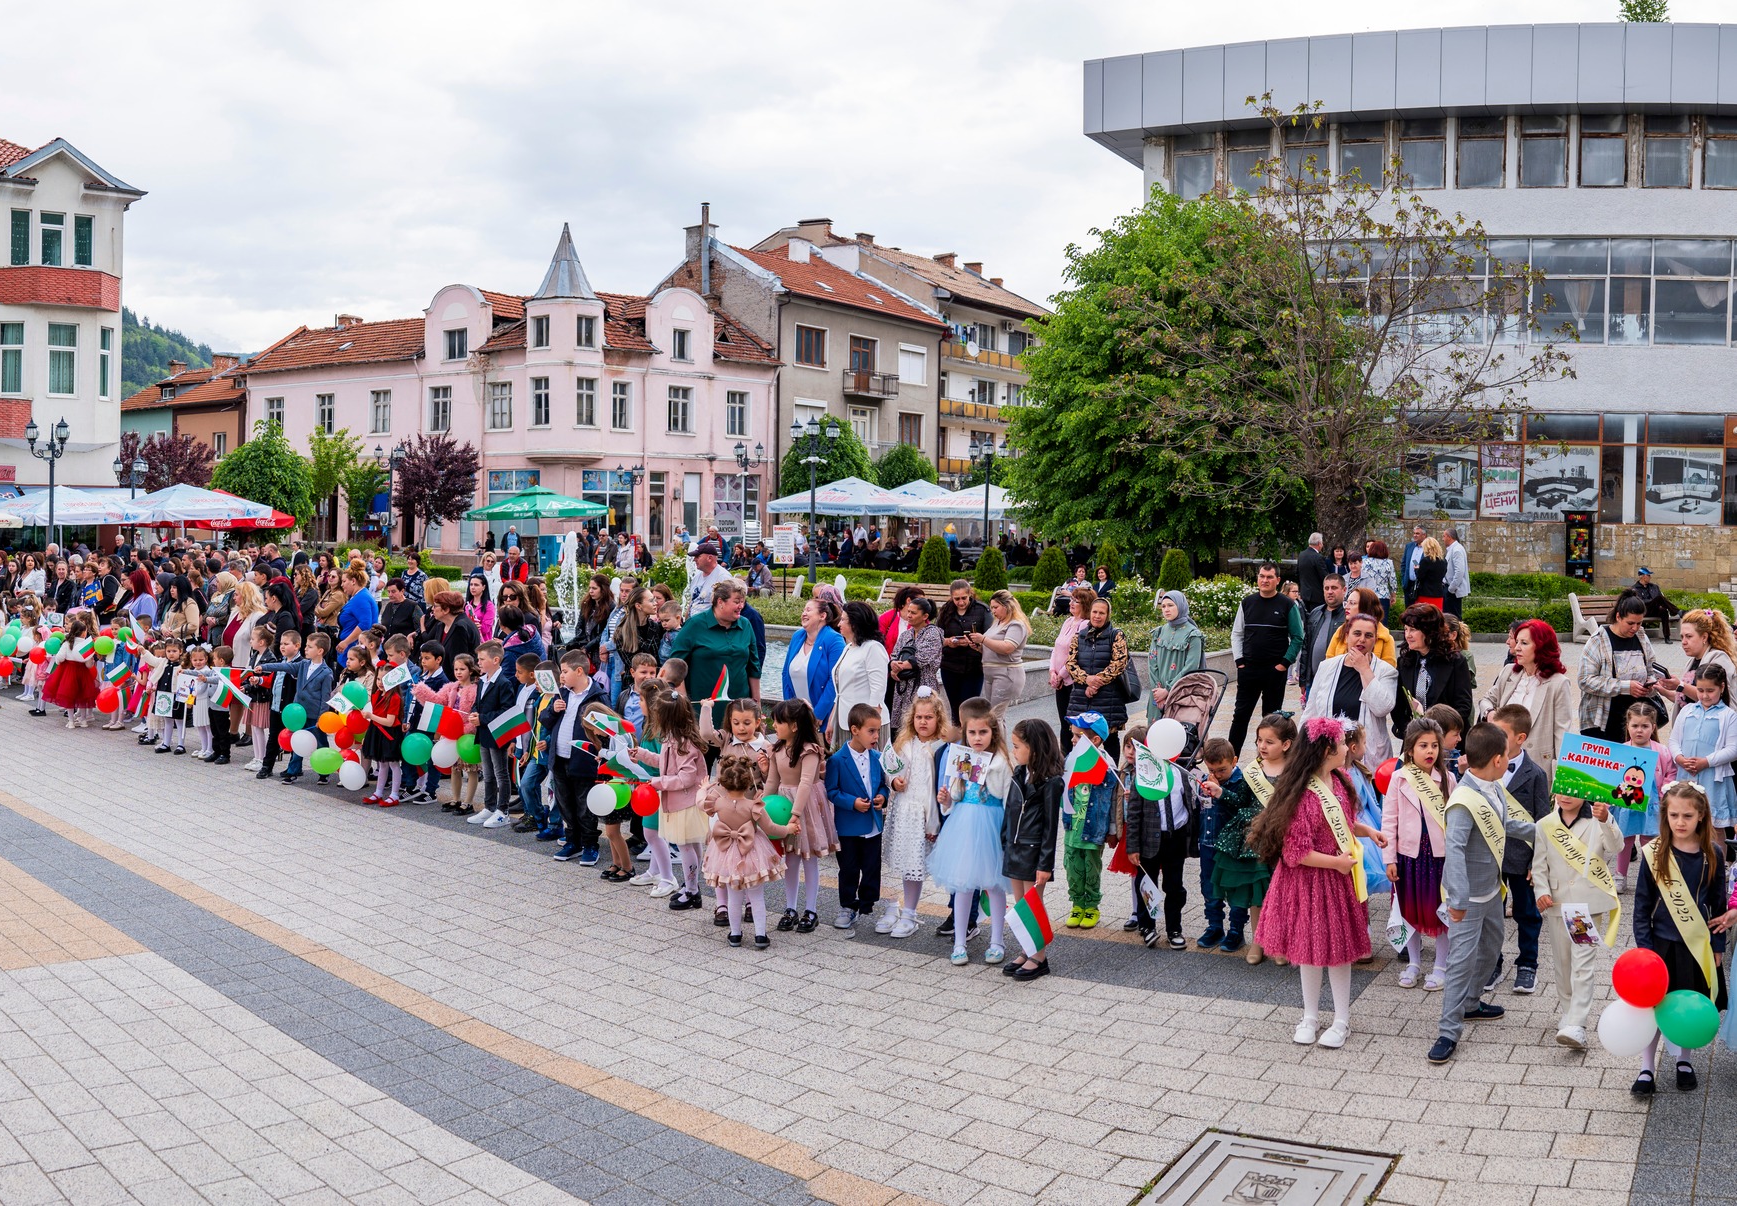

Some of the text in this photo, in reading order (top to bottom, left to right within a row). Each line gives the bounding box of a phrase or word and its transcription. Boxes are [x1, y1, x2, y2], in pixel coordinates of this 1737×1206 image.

[1485, 495, 1517, 510] ЦЕНИ
[1532, 512, 1559, 520] АМИ
[1581, 742, 1610, 756] ГРУПА
[1330, 816, 1349, 844] 2025
[1476, 804, 1504, 846] Випуск
[1669, 890, 1695, 923] 2025
